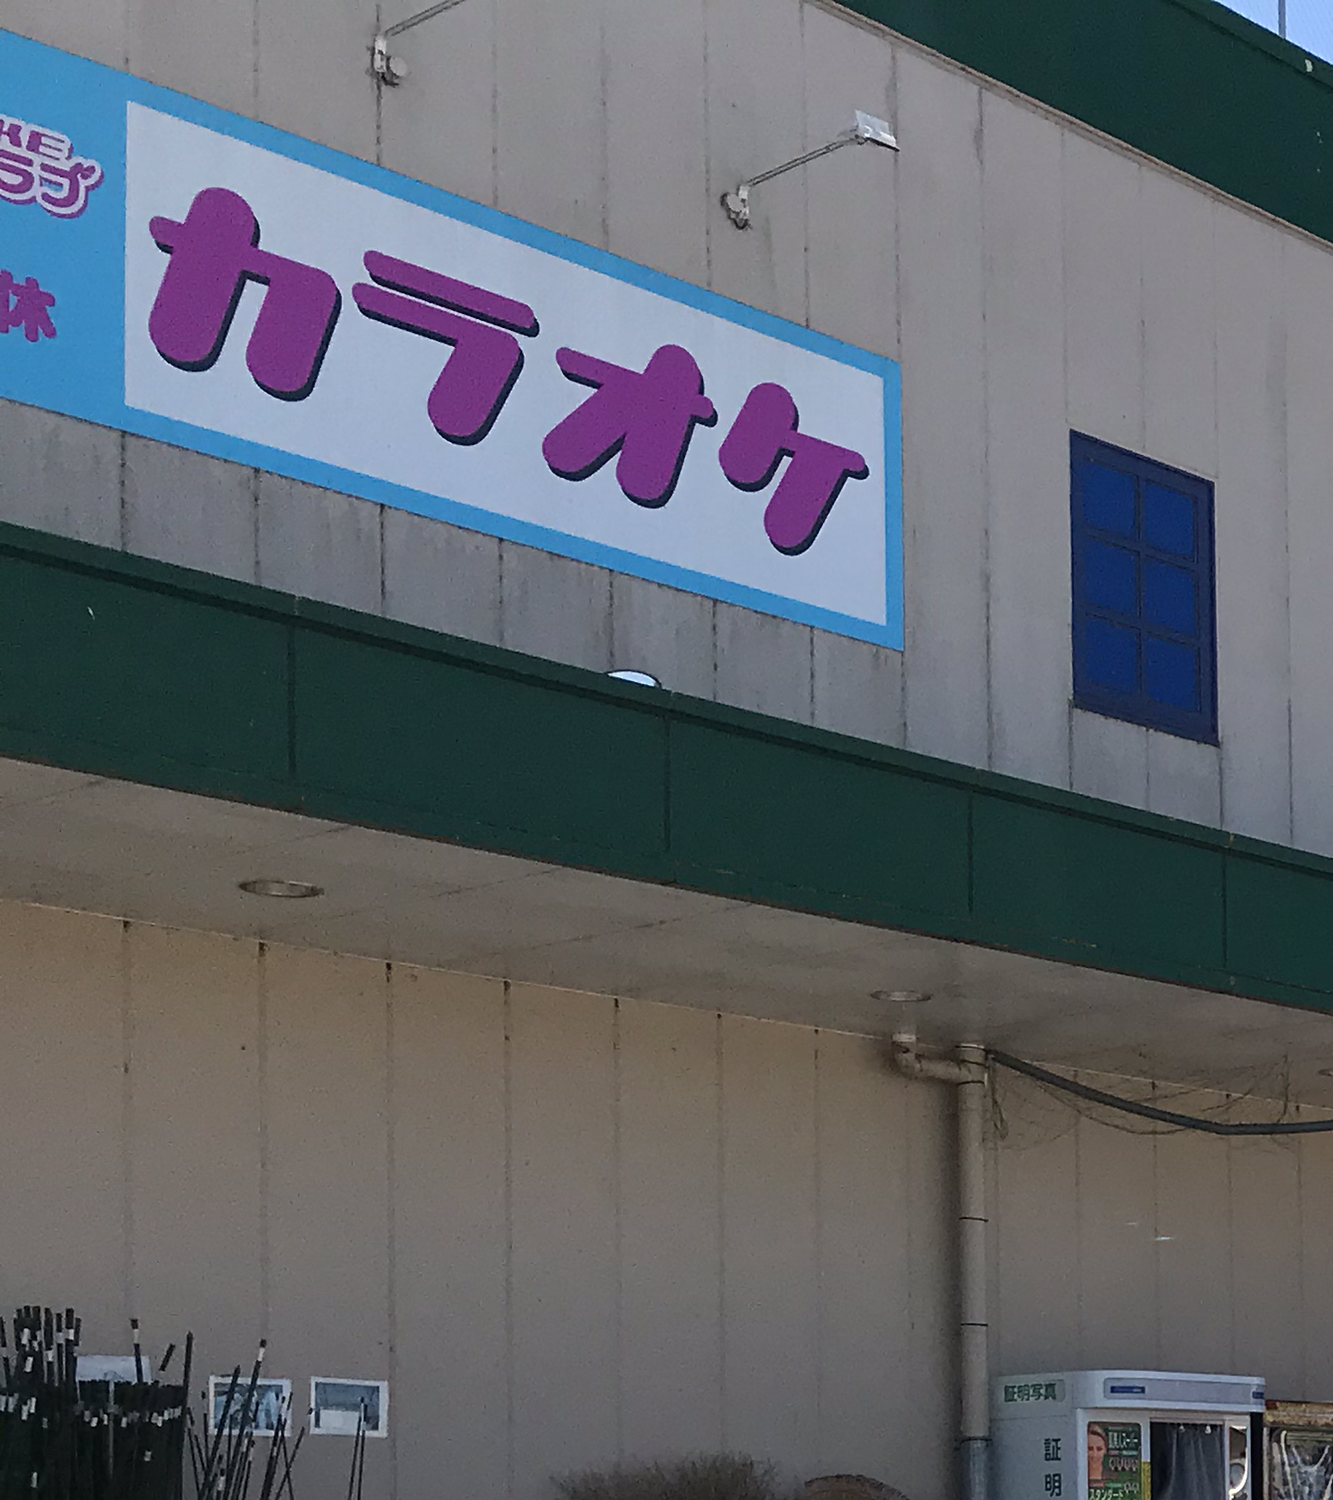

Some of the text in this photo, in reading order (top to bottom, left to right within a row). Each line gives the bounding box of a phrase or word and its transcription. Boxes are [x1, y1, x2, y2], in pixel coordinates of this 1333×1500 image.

[148, 187, 870, 556] カラオケ
[1004, 1383, 1057, 1402] 証明写真
